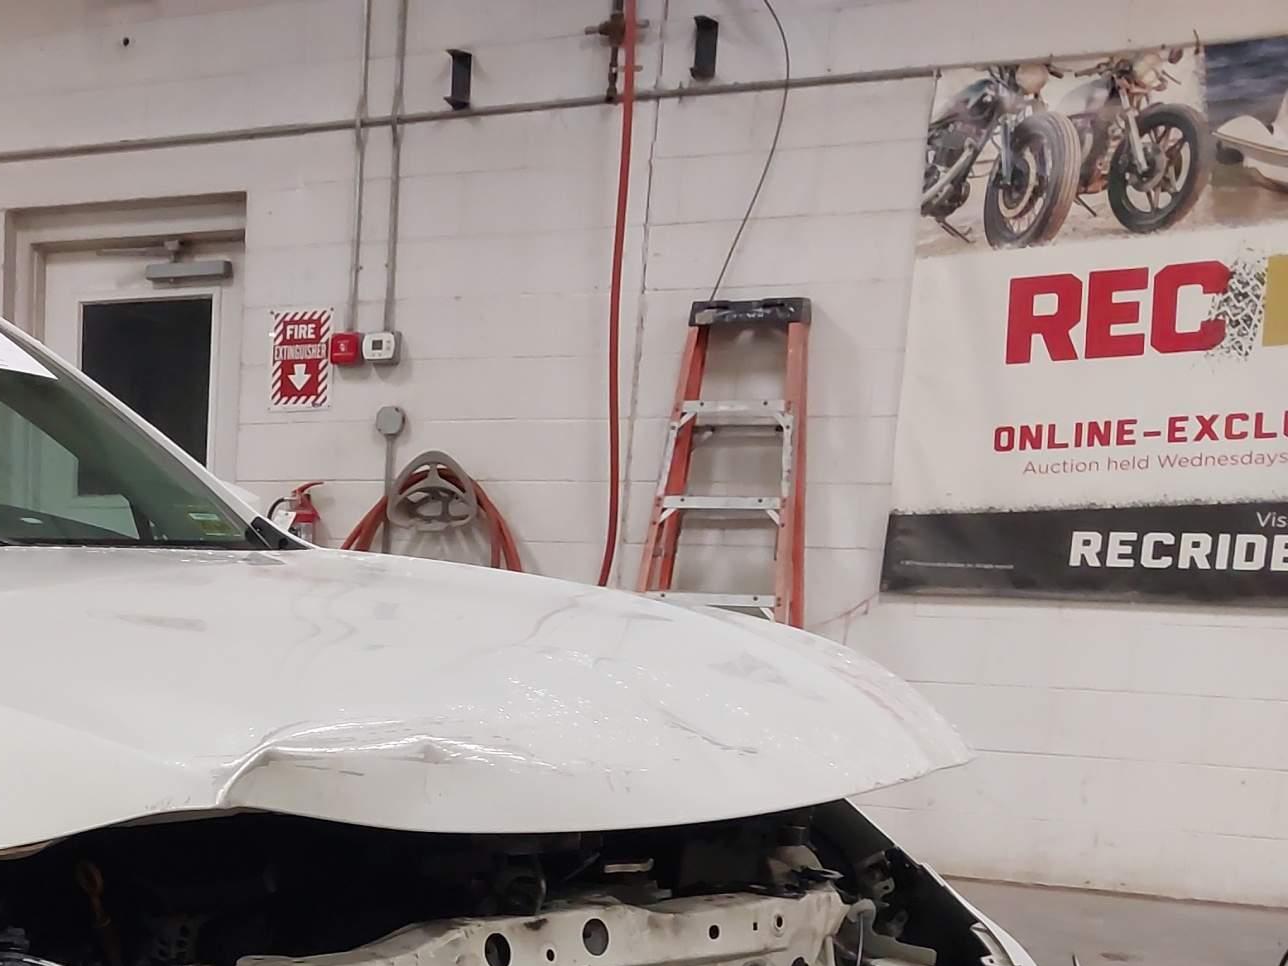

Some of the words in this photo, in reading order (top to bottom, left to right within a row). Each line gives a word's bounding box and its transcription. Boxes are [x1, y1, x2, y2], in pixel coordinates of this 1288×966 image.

[1006, 260, 1233, 365] REC
[286, 323, 316, 340] FIRE
[274, 344, 327, 361] EXTINGUISHER
[993, 410, 1288, 452] ONLINE-EXCL
[1022, 458, 1100, 475] Auction
[1107, 455, 1150, 472] held
[1157, 451, 1288, 470] Wednesdays
[1256, 511, 1288, 529] Vis
